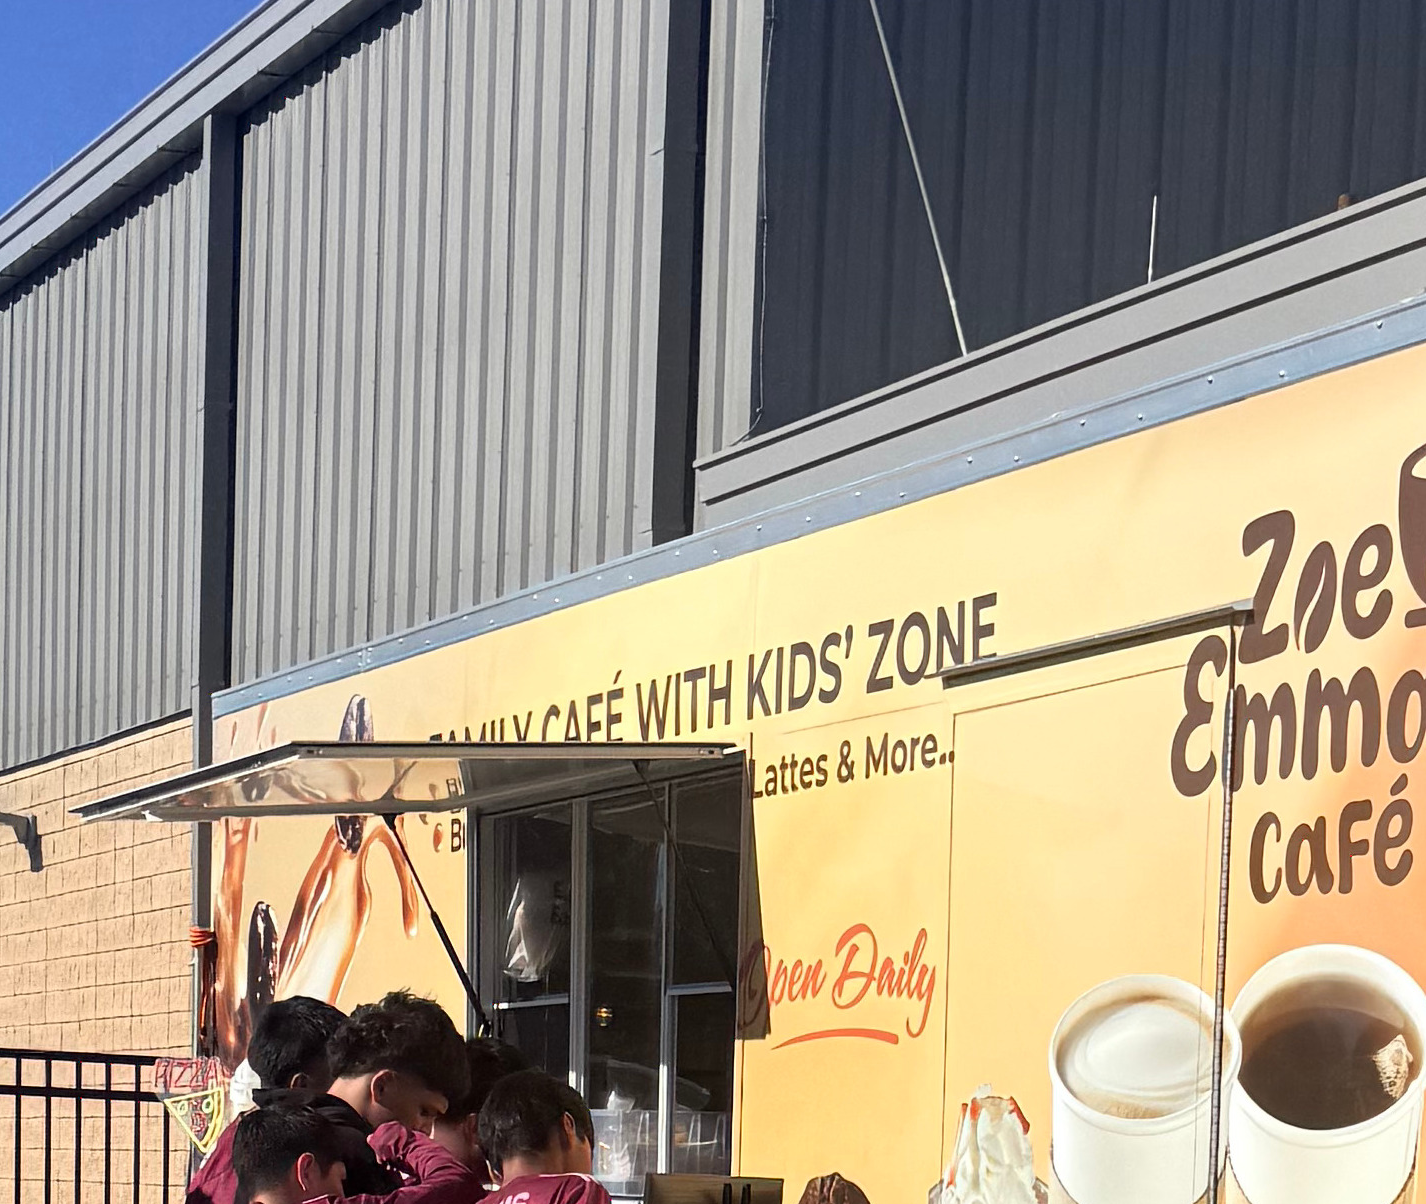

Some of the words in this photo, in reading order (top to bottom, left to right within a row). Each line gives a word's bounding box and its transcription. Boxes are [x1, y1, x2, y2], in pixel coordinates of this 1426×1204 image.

[1238, 509, 1393, 665] Zoe
[635, 660, 733, 742] WITH
[746, 624, 854, 721] KIDS'
[866, 591, 998, 694] ZONE
[753, 751, 829, 799] Lattes
[836, 739, 855, 783] &
[831, 922, 937, 1039] Daily
